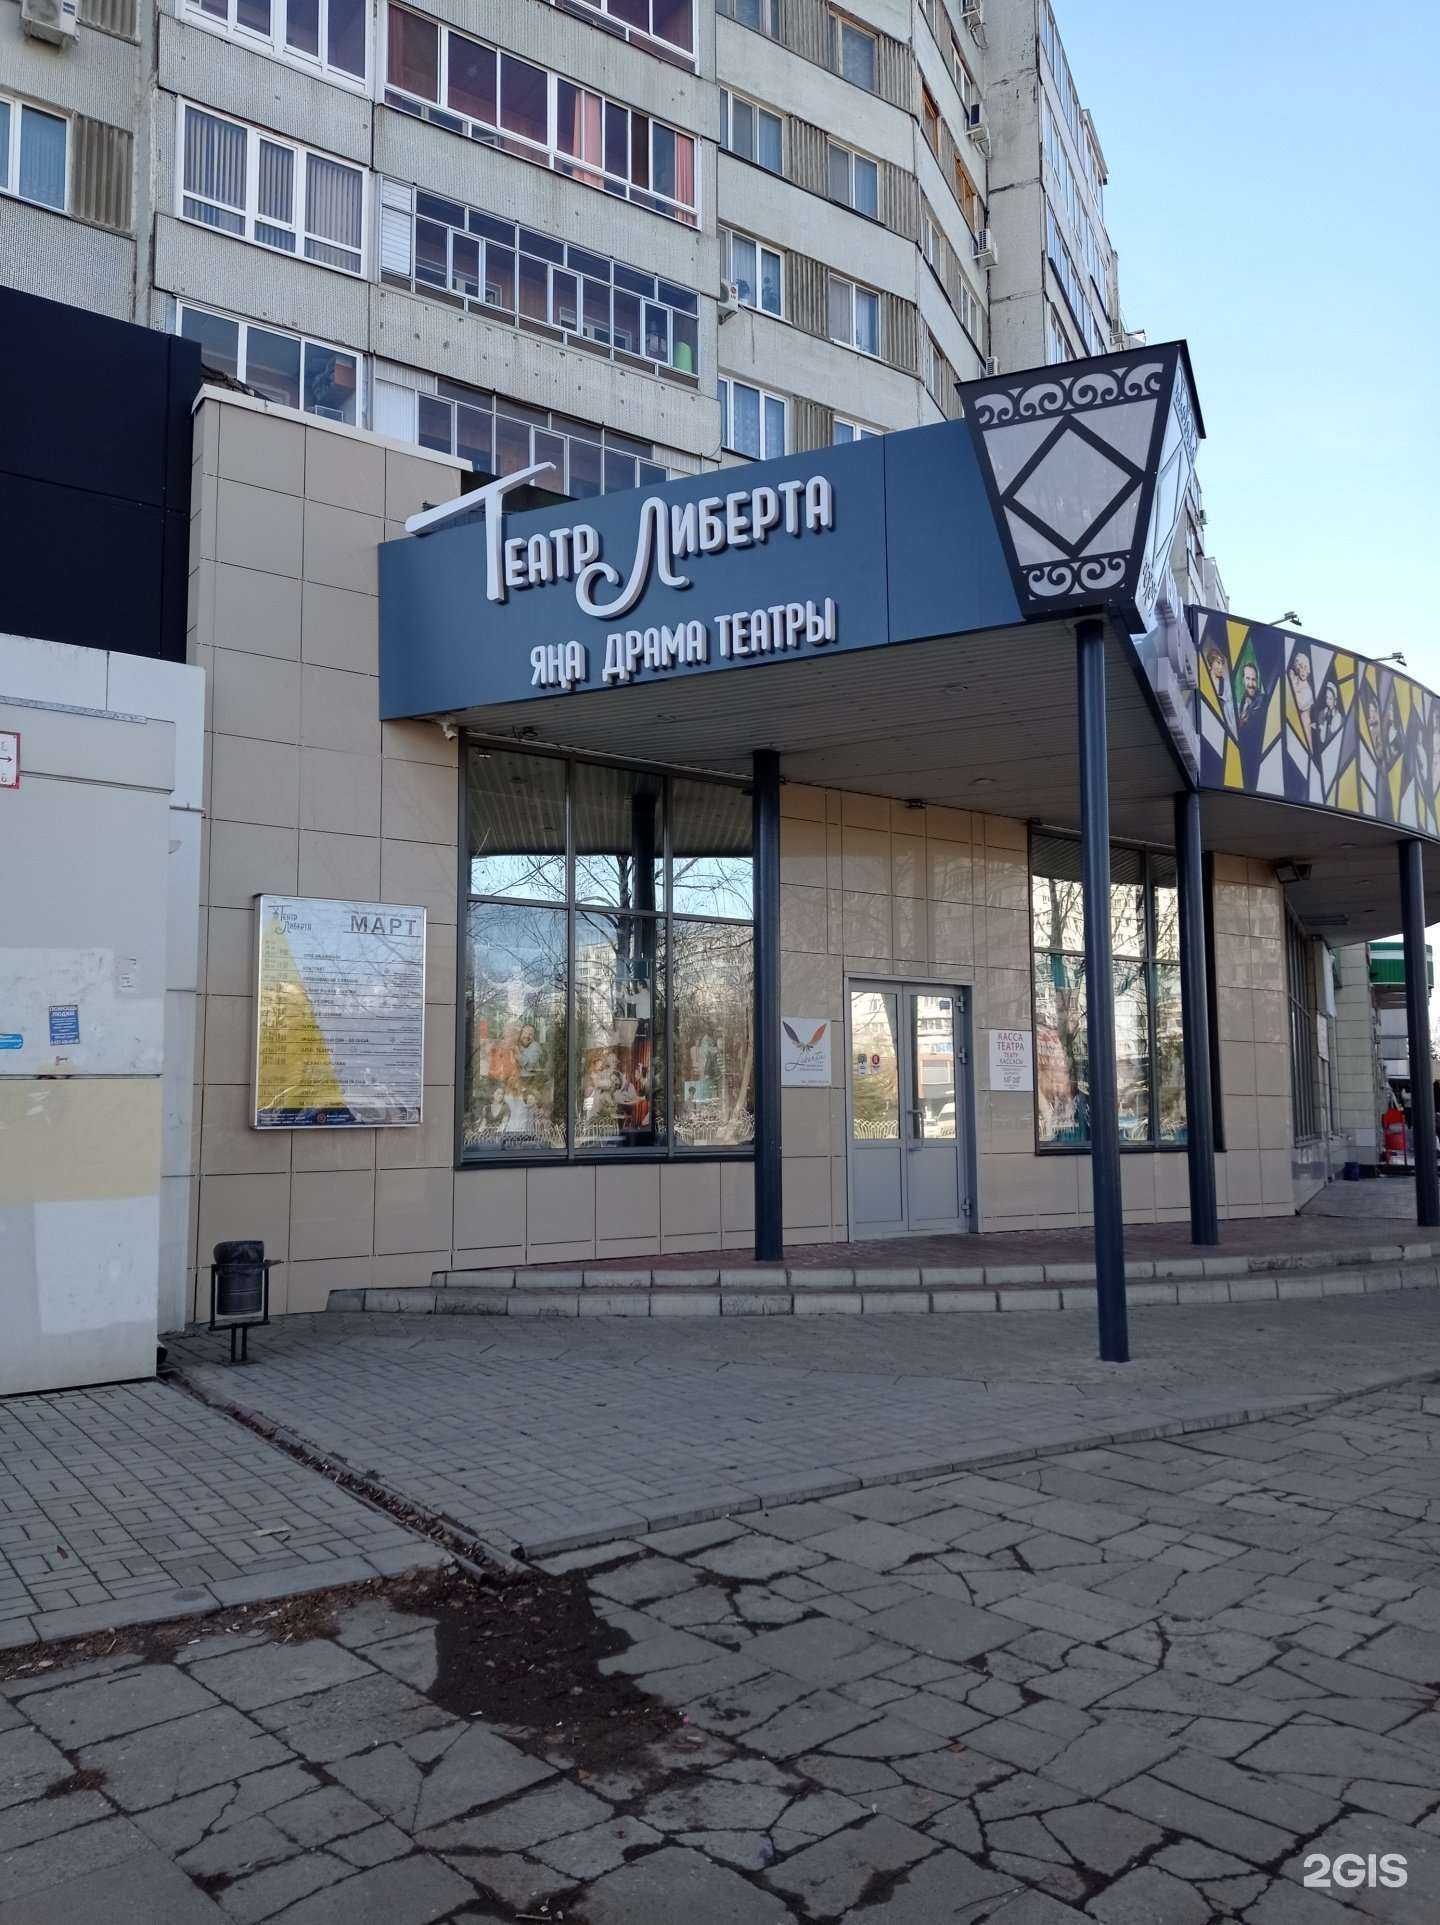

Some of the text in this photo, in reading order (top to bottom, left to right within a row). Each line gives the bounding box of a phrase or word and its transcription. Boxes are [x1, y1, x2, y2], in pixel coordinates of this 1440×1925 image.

[602, 620, 708, 685] ДРАМА
[714, 597, 837, 659] ТЕАТРЫ
[350, 914, 417, 936] МАРТ
[997, 1032, 1024, 1042] КАССА
[996, 1042, 1025, 1052] ТЕАТРА
